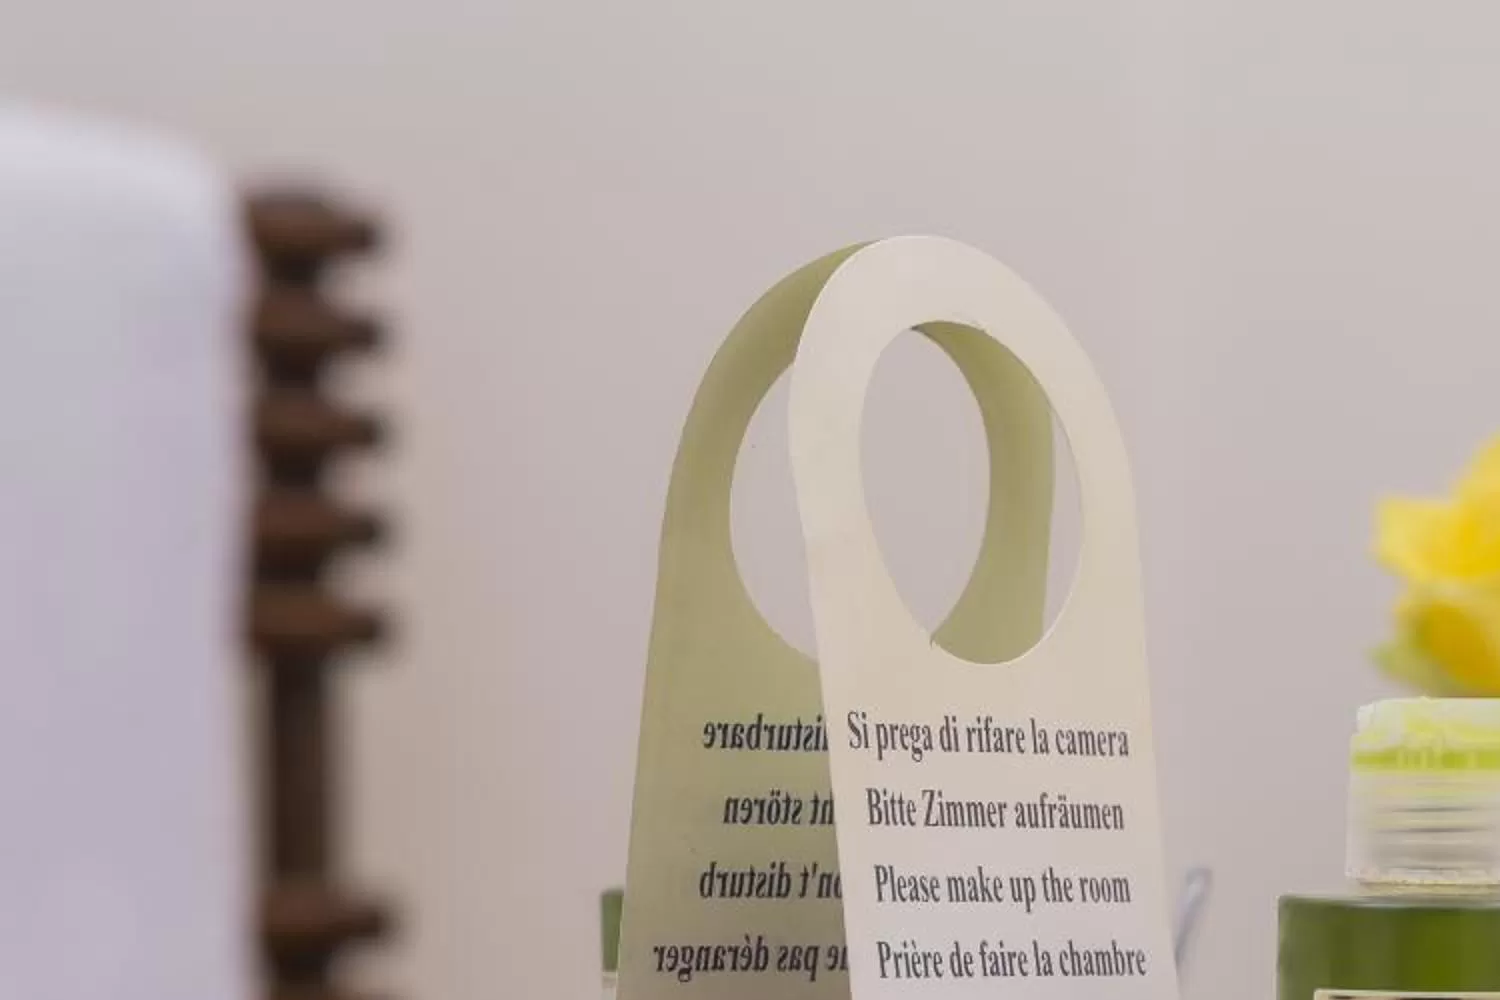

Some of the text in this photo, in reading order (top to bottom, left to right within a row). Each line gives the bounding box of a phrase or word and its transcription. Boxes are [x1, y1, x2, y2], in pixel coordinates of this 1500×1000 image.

[848, 711, 1129, 762] Si prega di rifare la camera
[866, 788, 916, 827] Bitte
[922, 790, 1007, 828] Zimmer
[1014, 792, 1124, 830] aufräumen
[874, 864, 1131, 914] Please make up the room
[876, 940, 1146, 978] Prière de faire la chambre
